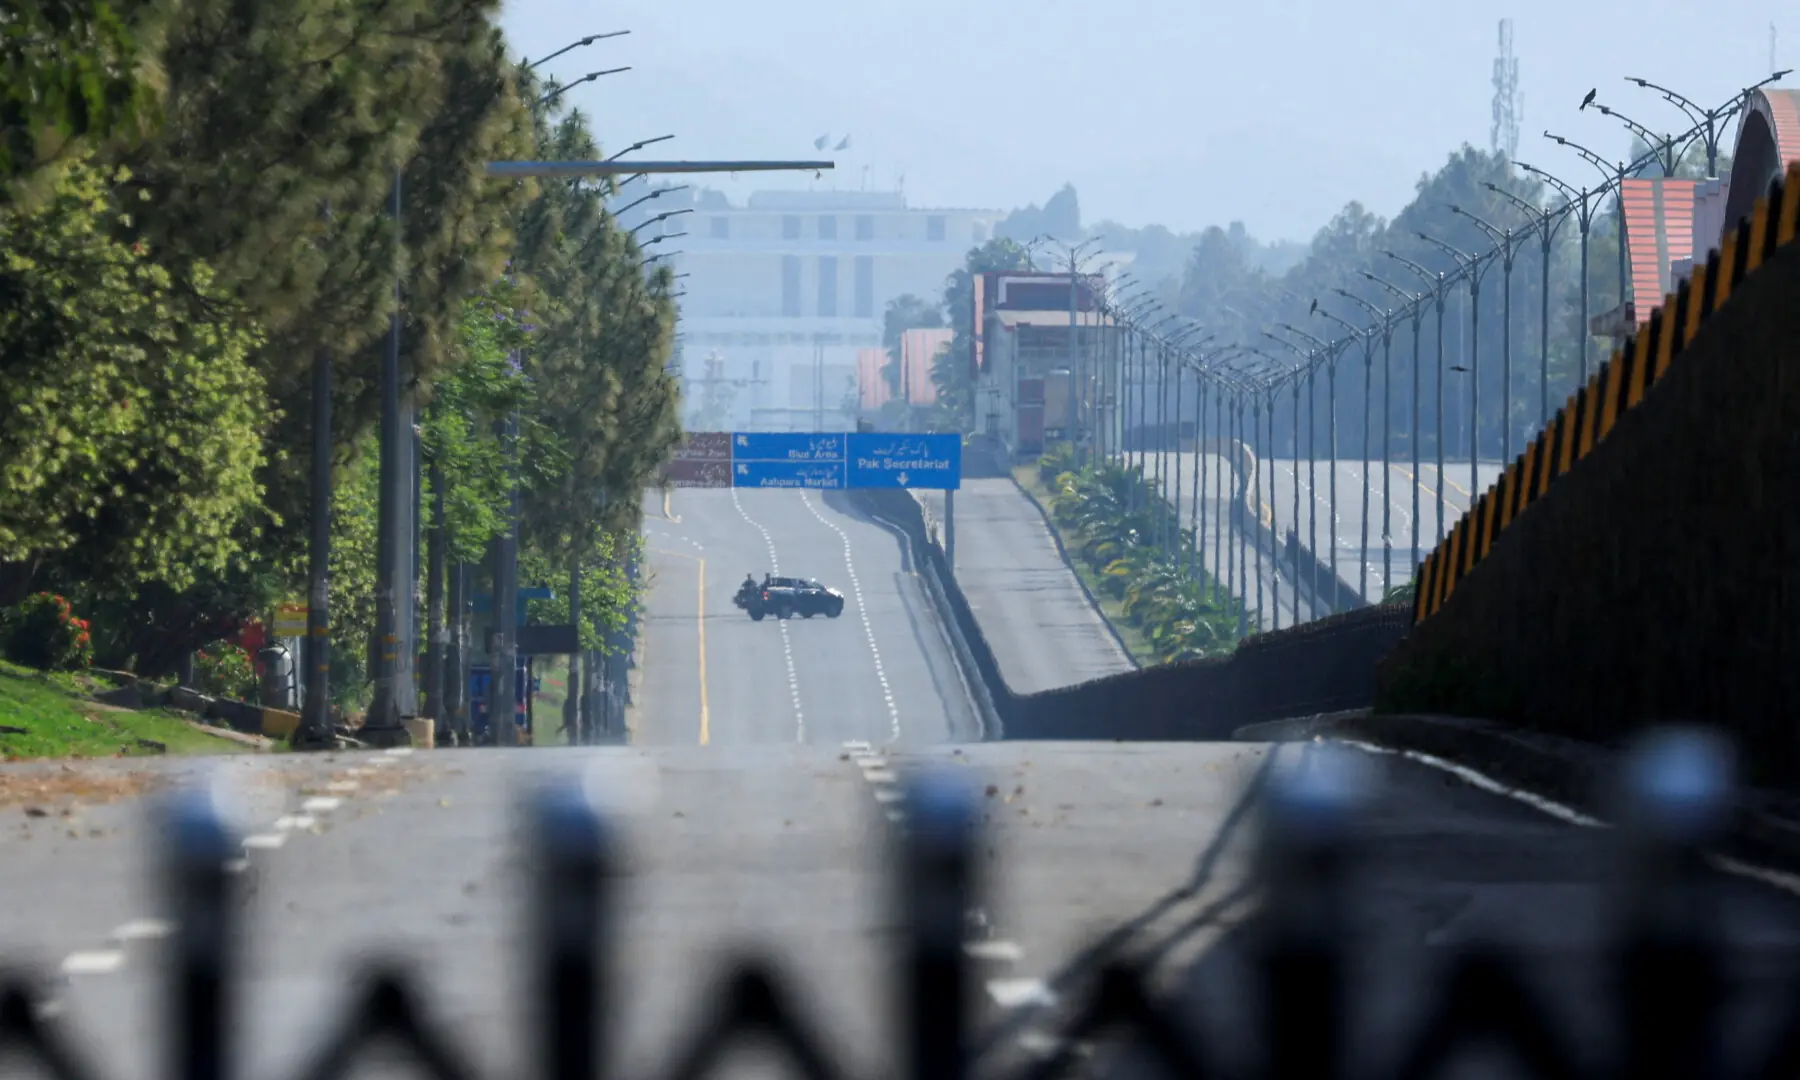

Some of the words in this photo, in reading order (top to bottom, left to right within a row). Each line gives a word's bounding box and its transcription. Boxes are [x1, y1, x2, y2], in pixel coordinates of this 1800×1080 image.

[788, 449, 810, 458] Blue
[814, 450, 838, 458] Area
[857, 458, 880, 469] Pak
[883, 458, 950, 469] Secretariat
[804, 478, 838, 487] Market
